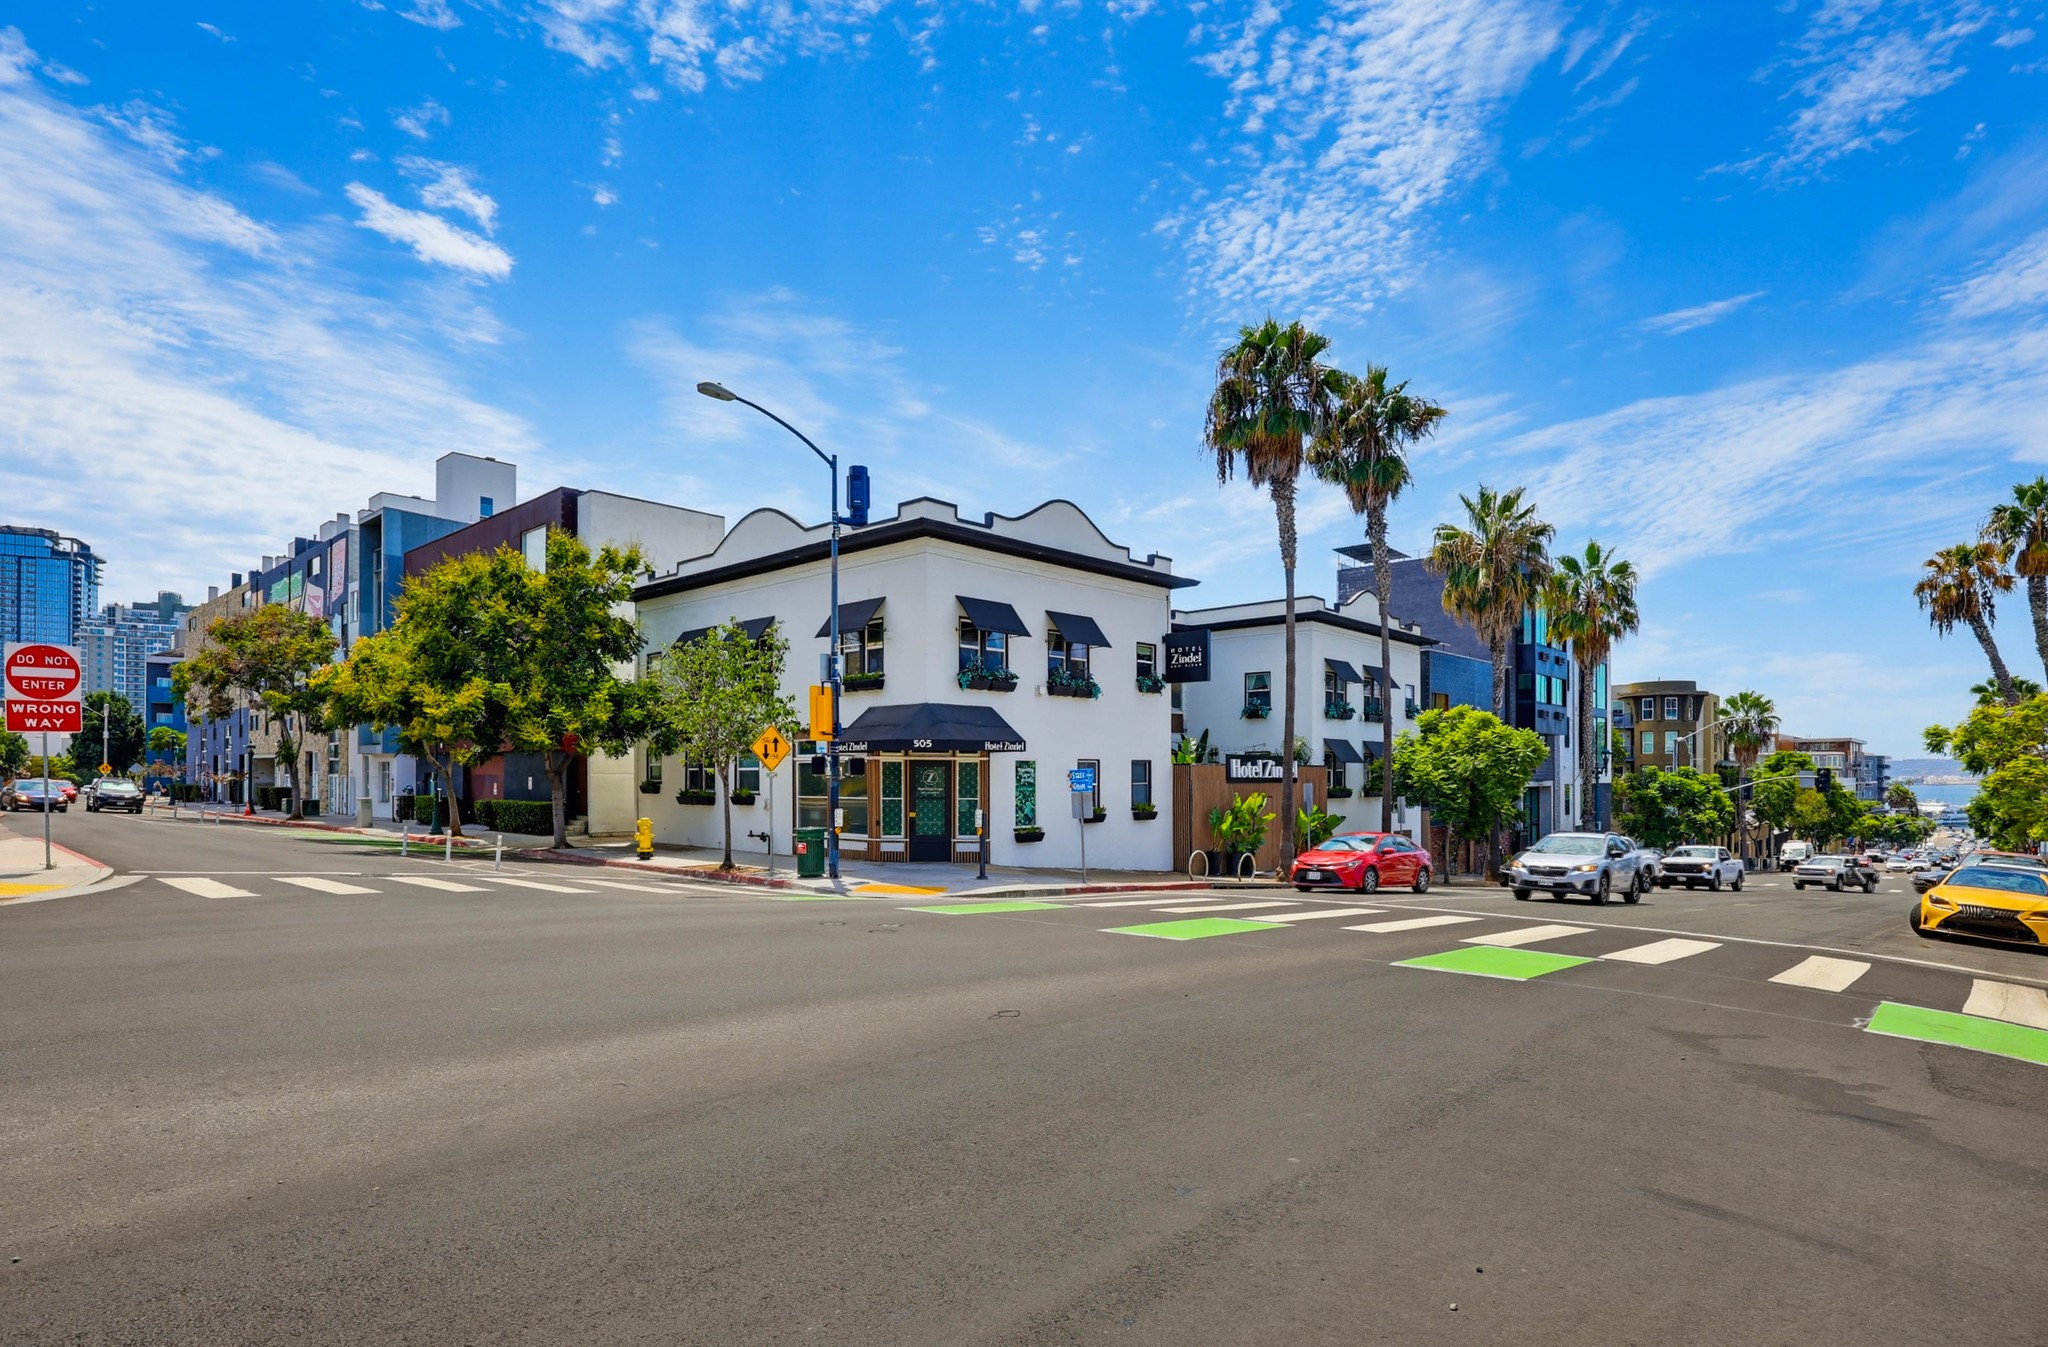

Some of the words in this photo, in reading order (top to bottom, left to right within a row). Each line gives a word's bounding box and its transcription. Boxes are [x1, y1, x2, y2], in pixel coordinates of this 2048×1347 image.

[16, 654, 35, 664] DO
[44, 655, 70, 666] NOT
[1171, 652, 1202, 664] Zindel
[22, 679, 65, 690] ENTER
[11, 703, 76, 714] WRONG
[24, 718, 64, 728] WAY
[913, 739, 933, 748] 505
[985, 741, 1003, 751] Hotel
[1003, 741, 1025, 751] Zindel
[1230, 758, 1263, 778] Hotel
[1262, 759, 1298, 778] Zinl
